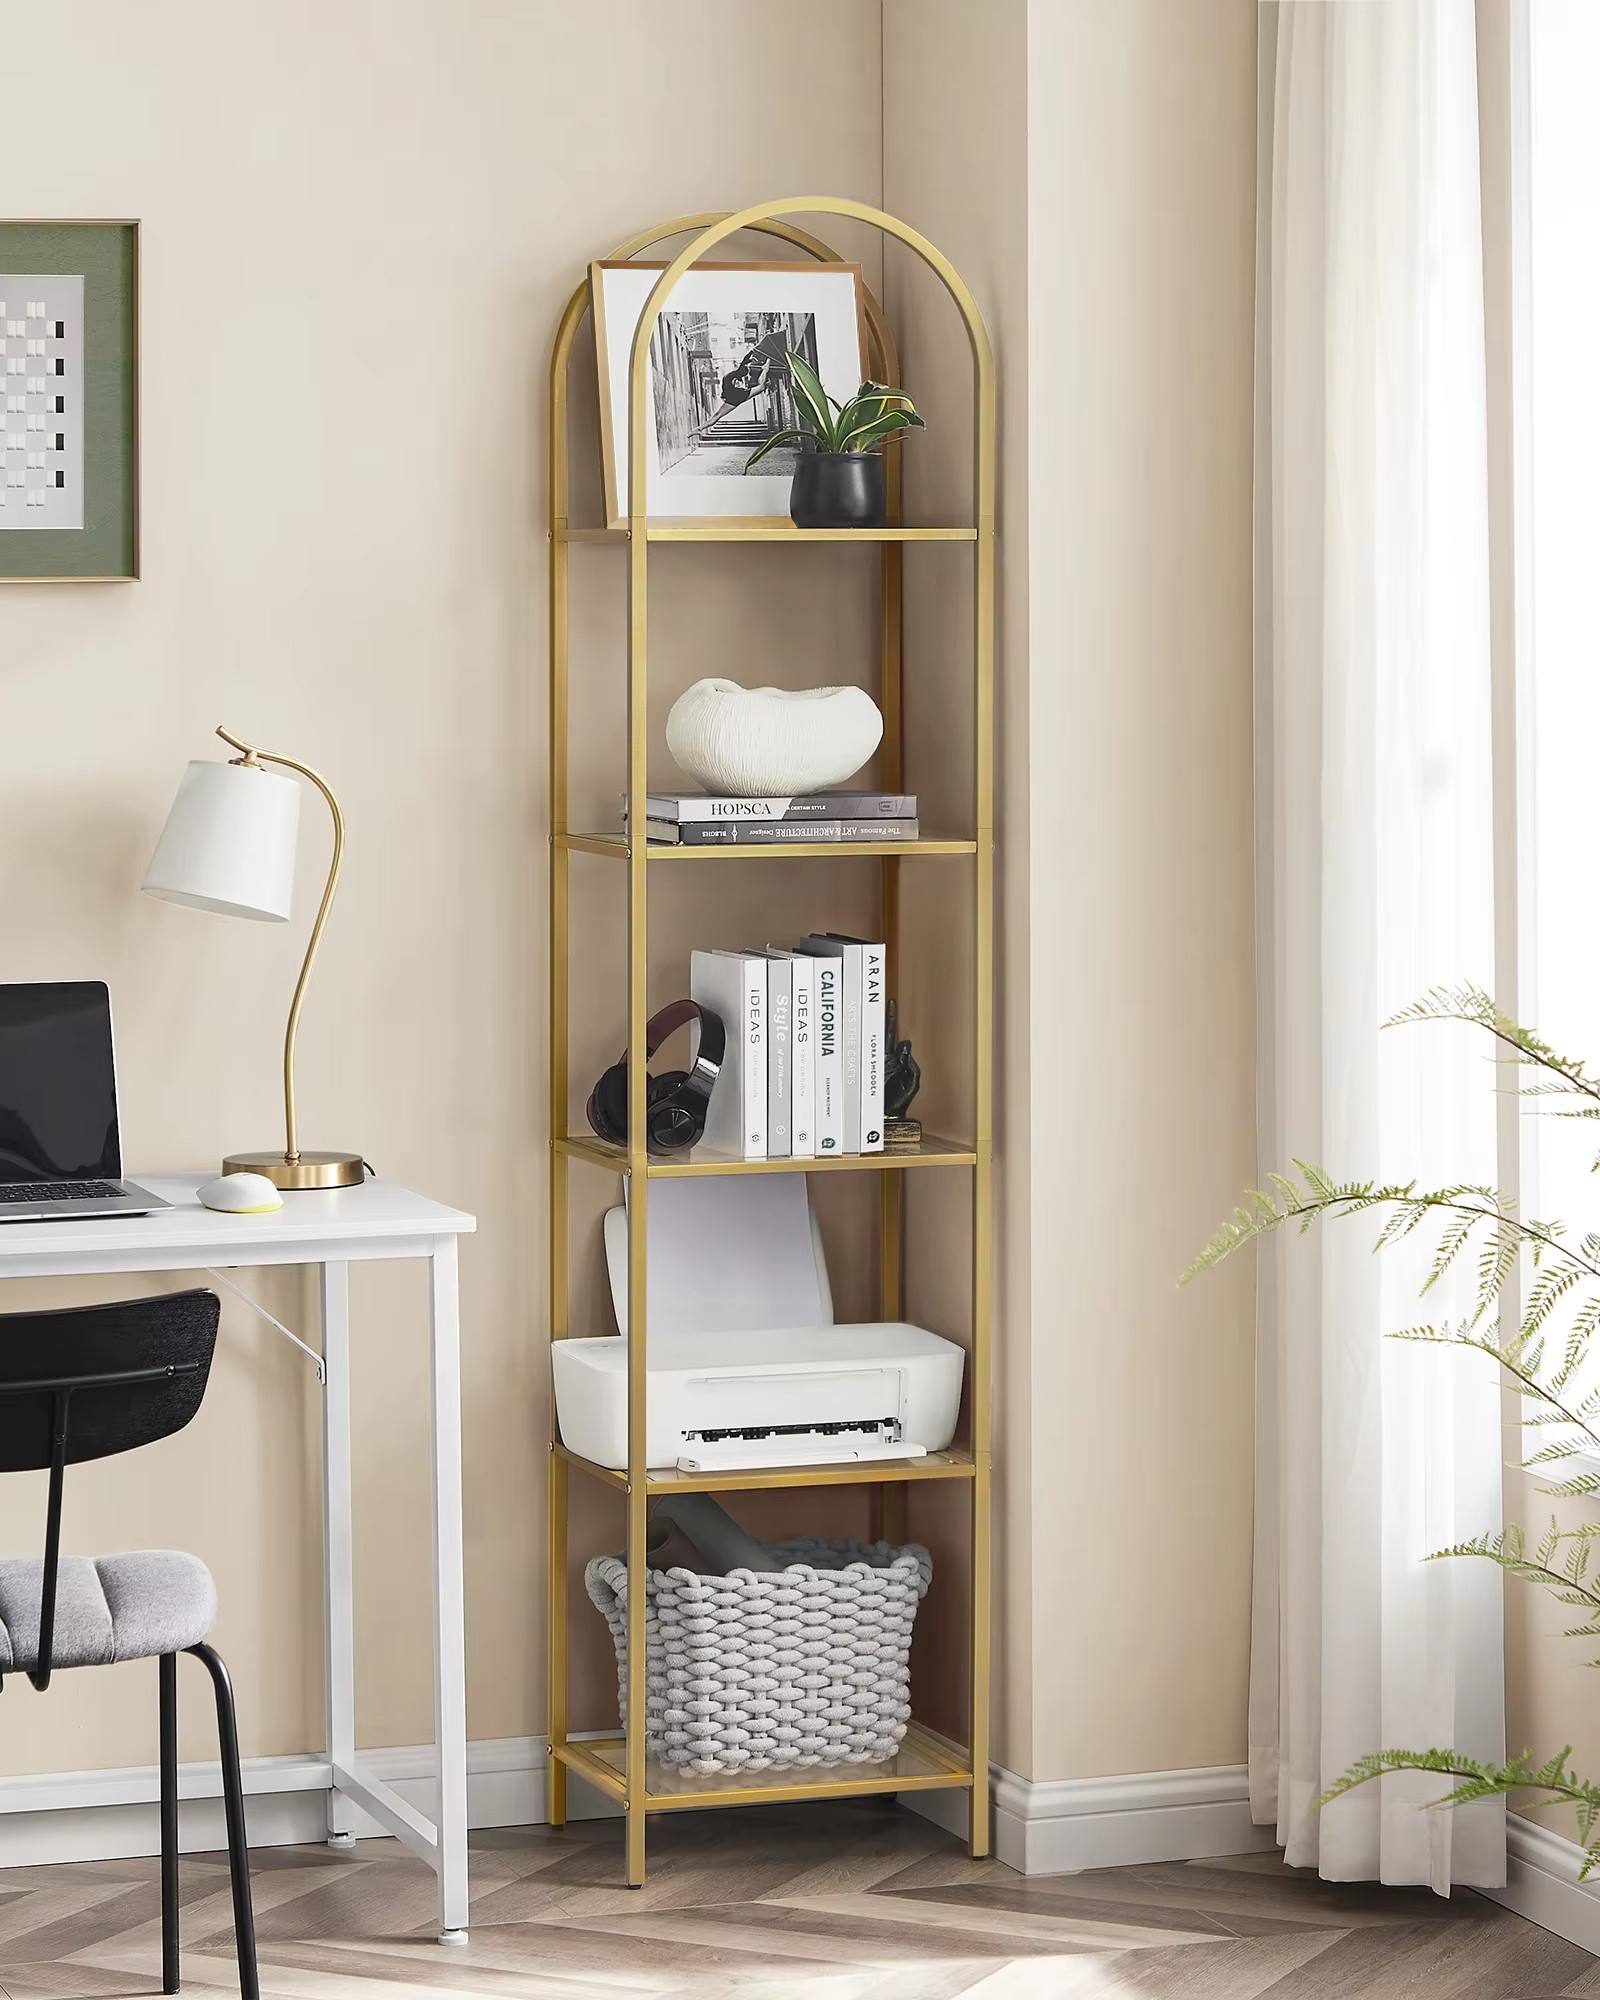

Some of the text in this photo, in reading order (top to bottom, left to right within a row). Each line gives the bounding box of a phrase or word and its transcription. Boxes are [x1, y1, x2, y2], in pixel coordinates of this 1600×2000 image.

[711, 803, 772, 815] HOPSCA
[776, 828, 834, 836] ARCHITECTURE
[842, 827, 857, 835] ART
[868, 955, 879, 1003] ARAN
[750, 989, 760, 1044] IDEAS
[774, 994, 789, 1041] Style
[798, 988, 808, 1043] IDEAS
[821, 970, 835, 1056] CALIFORNIA
